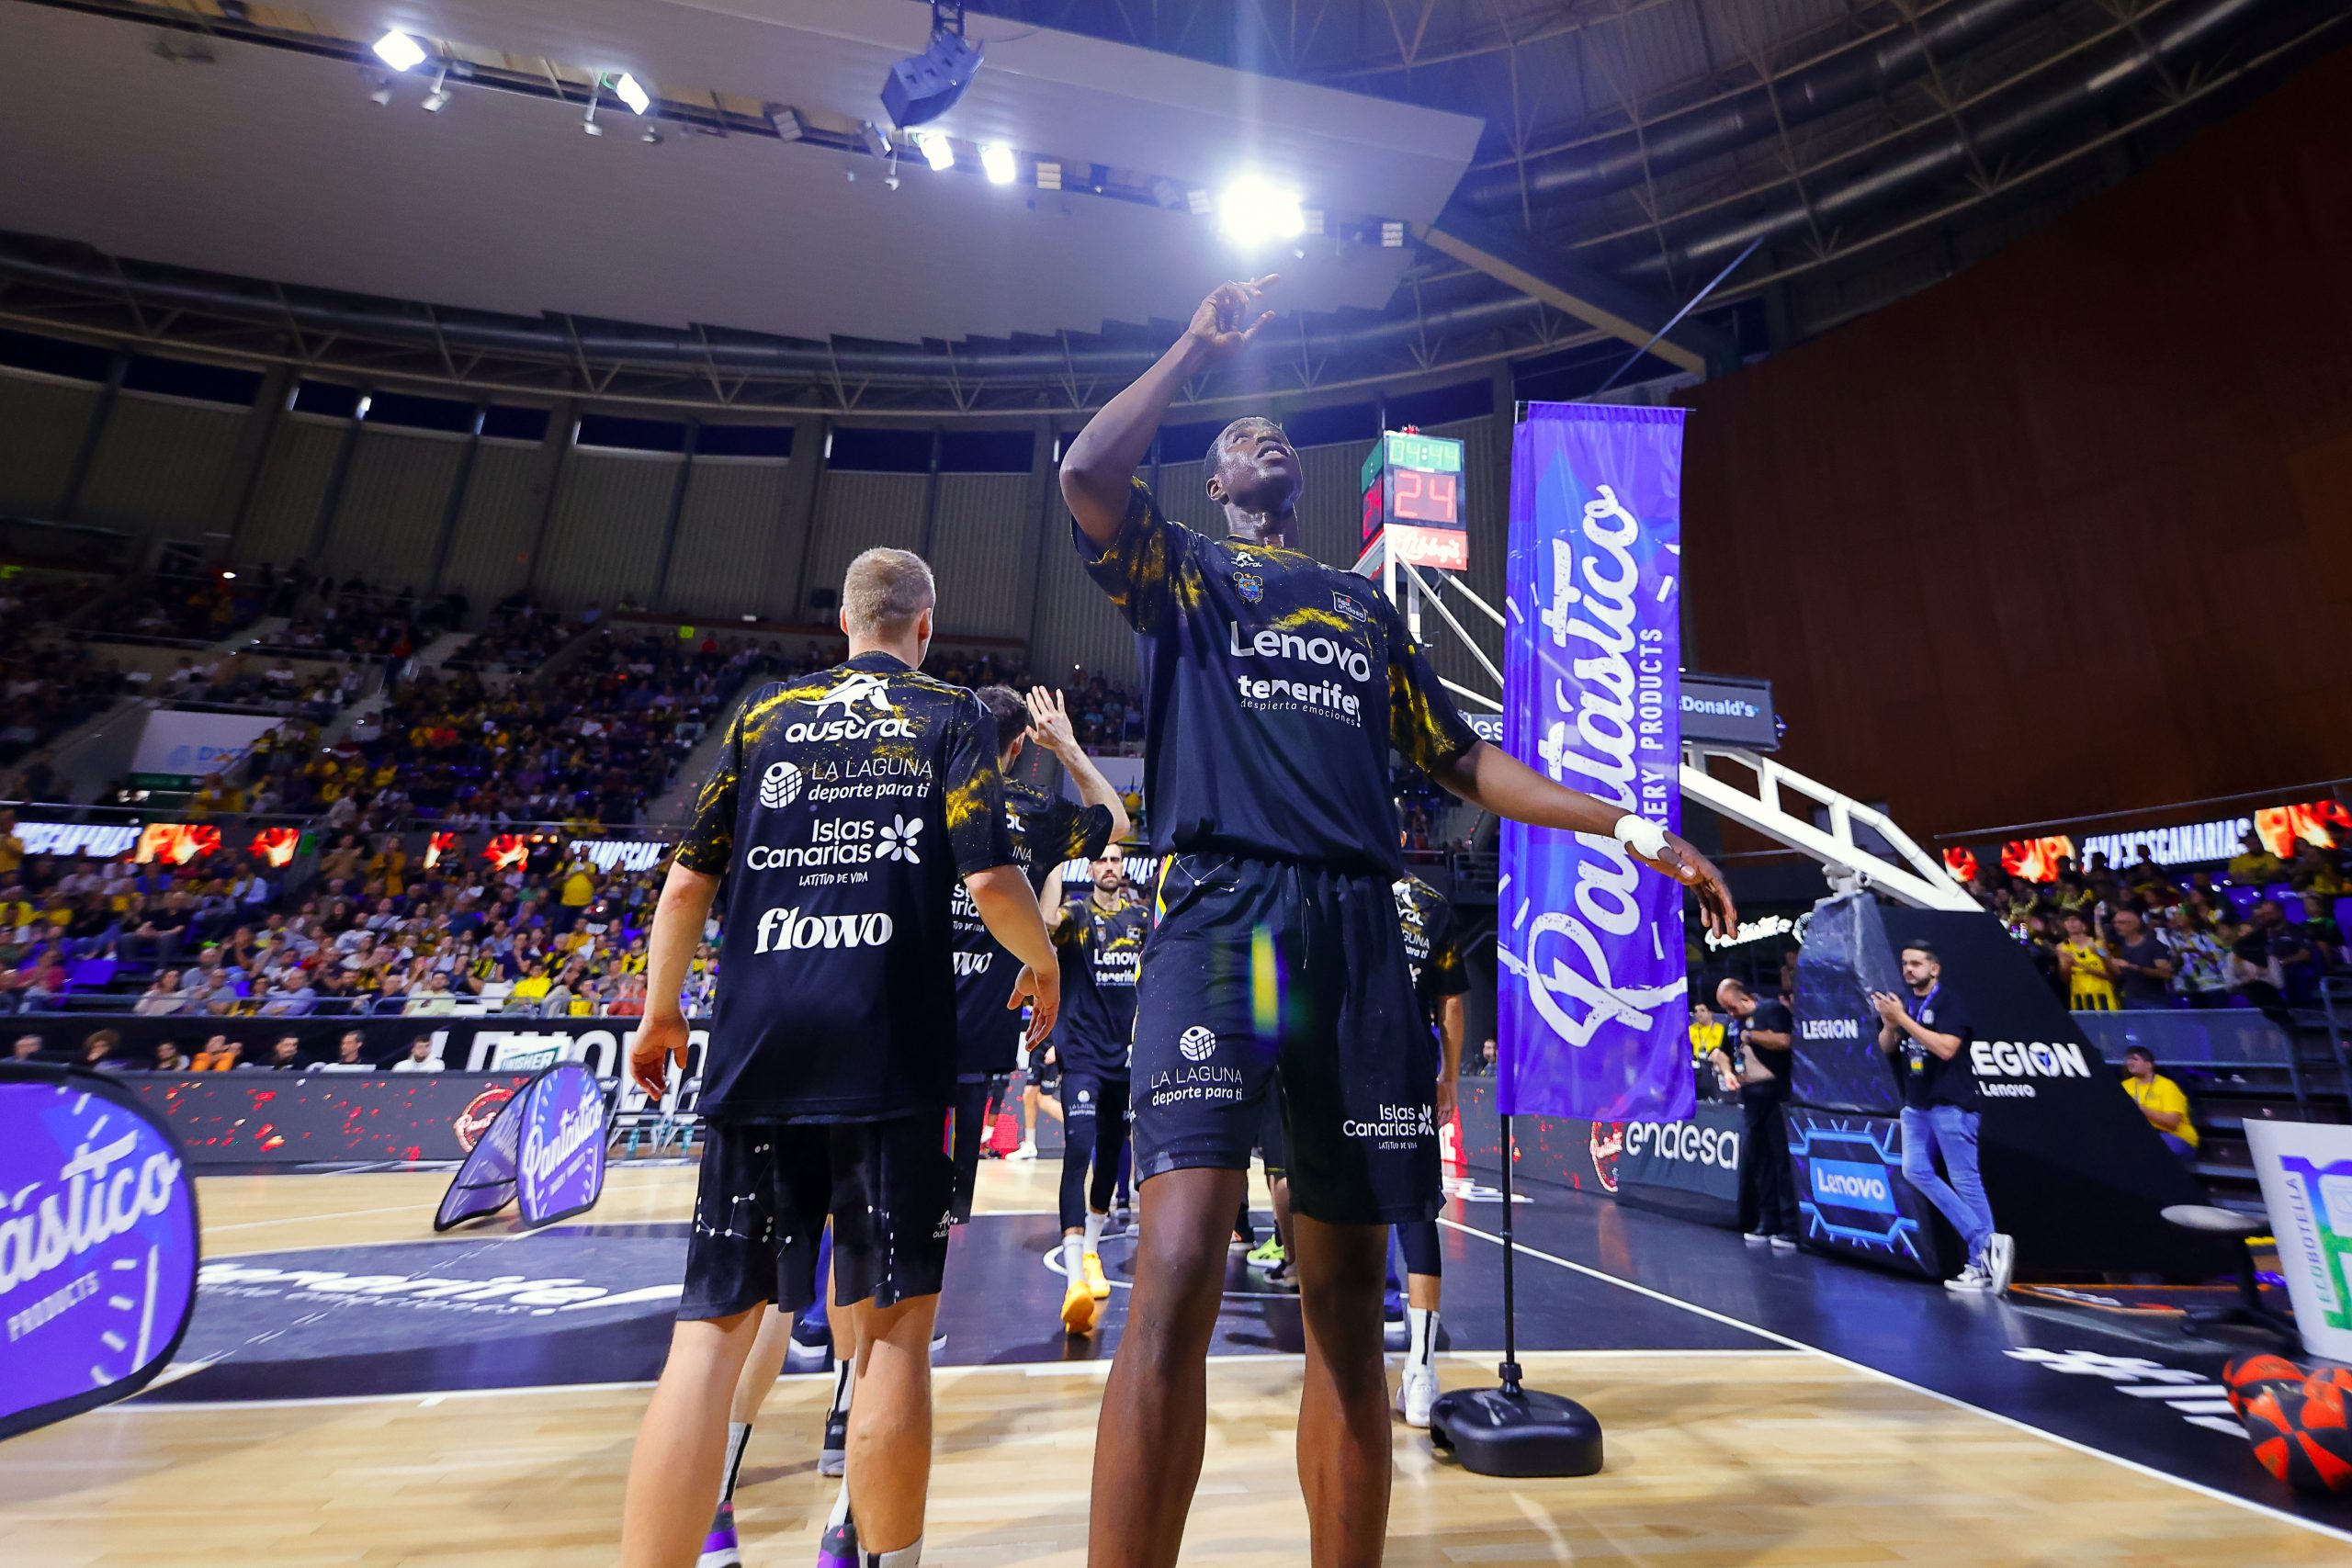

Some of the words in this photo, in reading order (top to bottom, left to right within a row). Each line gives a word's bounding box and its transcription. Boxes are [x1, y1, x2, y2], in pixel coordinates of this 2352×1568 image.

[1395, 472, 1454, 521] 24
[1230, 621, 1371, 682] Lenovo
[1640, 627, 1664, 750] PRODUCTS
[1240, 698, 1297, 712] despierta
[1303, 704, 1355, 726] emociones
[1679, 694, 1756, 717] Donald's
[785, 718, 917, 743] austral
[811, 761, 839, 781] LA
[845, 758, 933, 779] LAGUNA
[808, 783, 873, 804] deporte
[875, 783, 913, 800] para
[917, 782, 931, 798] ti
[1641, 769, 1668, 830] KERY
[811, 818, 874, 843] Islas
[747, 840, 872, 871] Canarias
[798, 874, 835, 887] LATITUD
[837, 872, 848, 884] DE
[850, 871, 868, 885] VIDA
[753, 906, 893, 954] flowo
[1093, 948, 1138, 965] Lenov
[1802, 1019, 1859, 1041] LEGION
[1970, 1041, 2091, 1078] EGION
[1151, 1070, 1171, 1089] LA
[1176, 1066, 1242, 1085] LAGUNA
[1979, 1080, 2037, 1099] Lenovo
[1151, 1087, 1202, 1107] deporte
[1205, 1087, 1233, 1101] para
[1234, 1088, 1242, 1101] ti
[1379, 1103, 1416, 1121] Islas
[1343, 1118, 1417, 1137] Canarias
[1625, 1120, 1740, 1170] endesa
[1816, 1167, 1885, 1201] Lenovo
